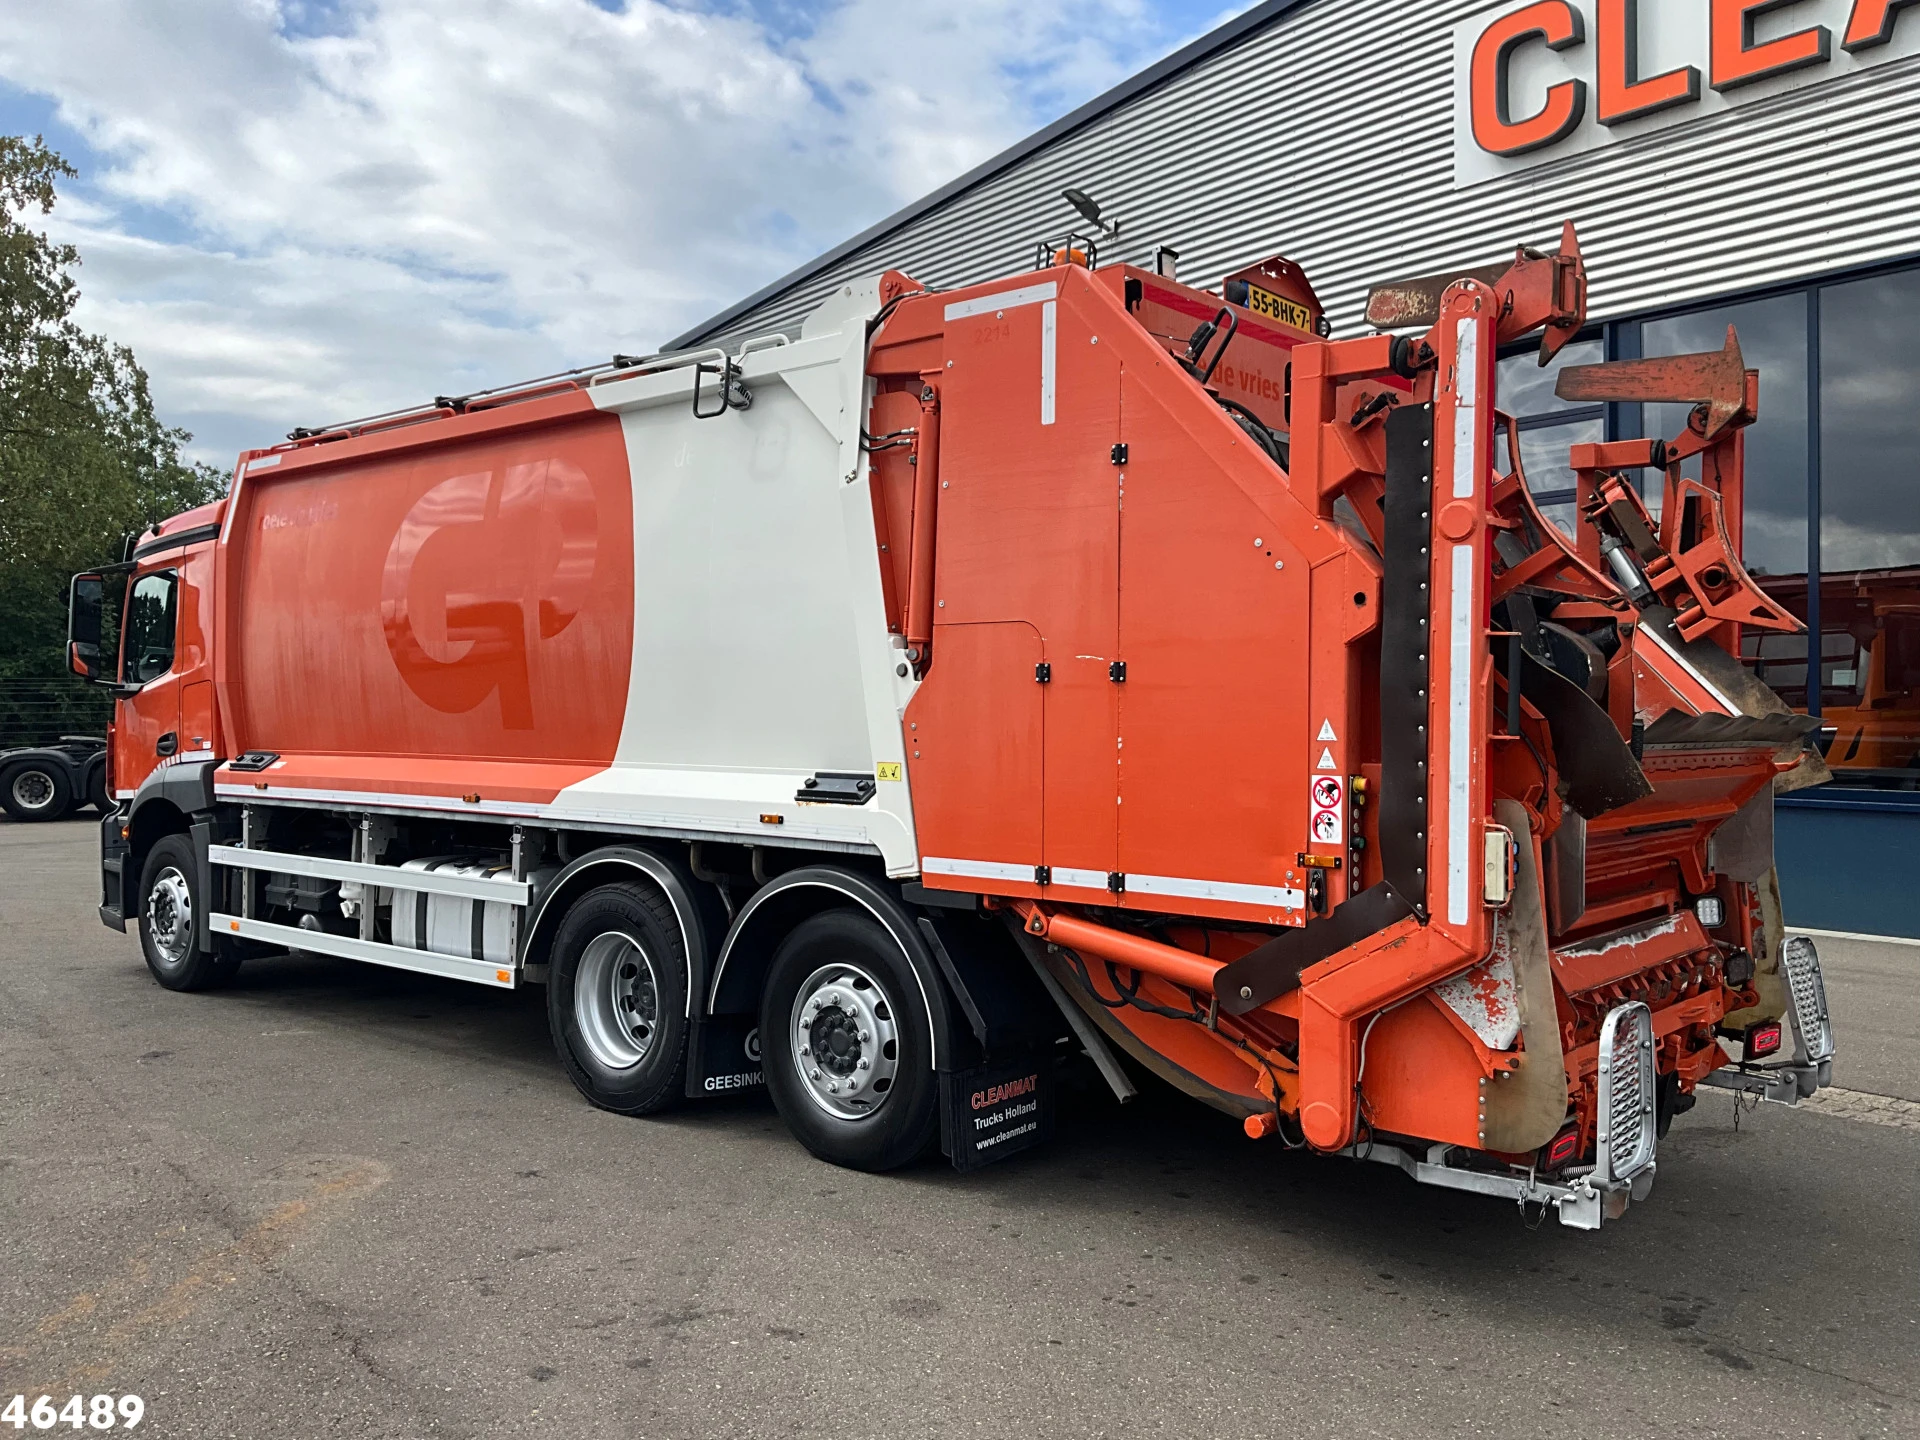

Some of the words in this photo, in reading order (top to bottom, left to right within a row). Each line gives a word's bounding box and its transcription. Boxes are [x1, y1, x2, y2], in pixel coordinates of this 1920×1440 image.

[1471, 0, 1920, 157] CLE
[1252, 289, 1308, 329] 55-BHK-7
[1212, 362, 1235, 388] de
[1239, 367, 1281, 402] vries
[971, 1074, 1038, 1110] CLEANMAT
[974, 1112, 1004, 1131] Trucks
[1005, 1099, 1037, 1120] Holland
[976, 1121, 1037, 1151] www.cleanmat.eu
